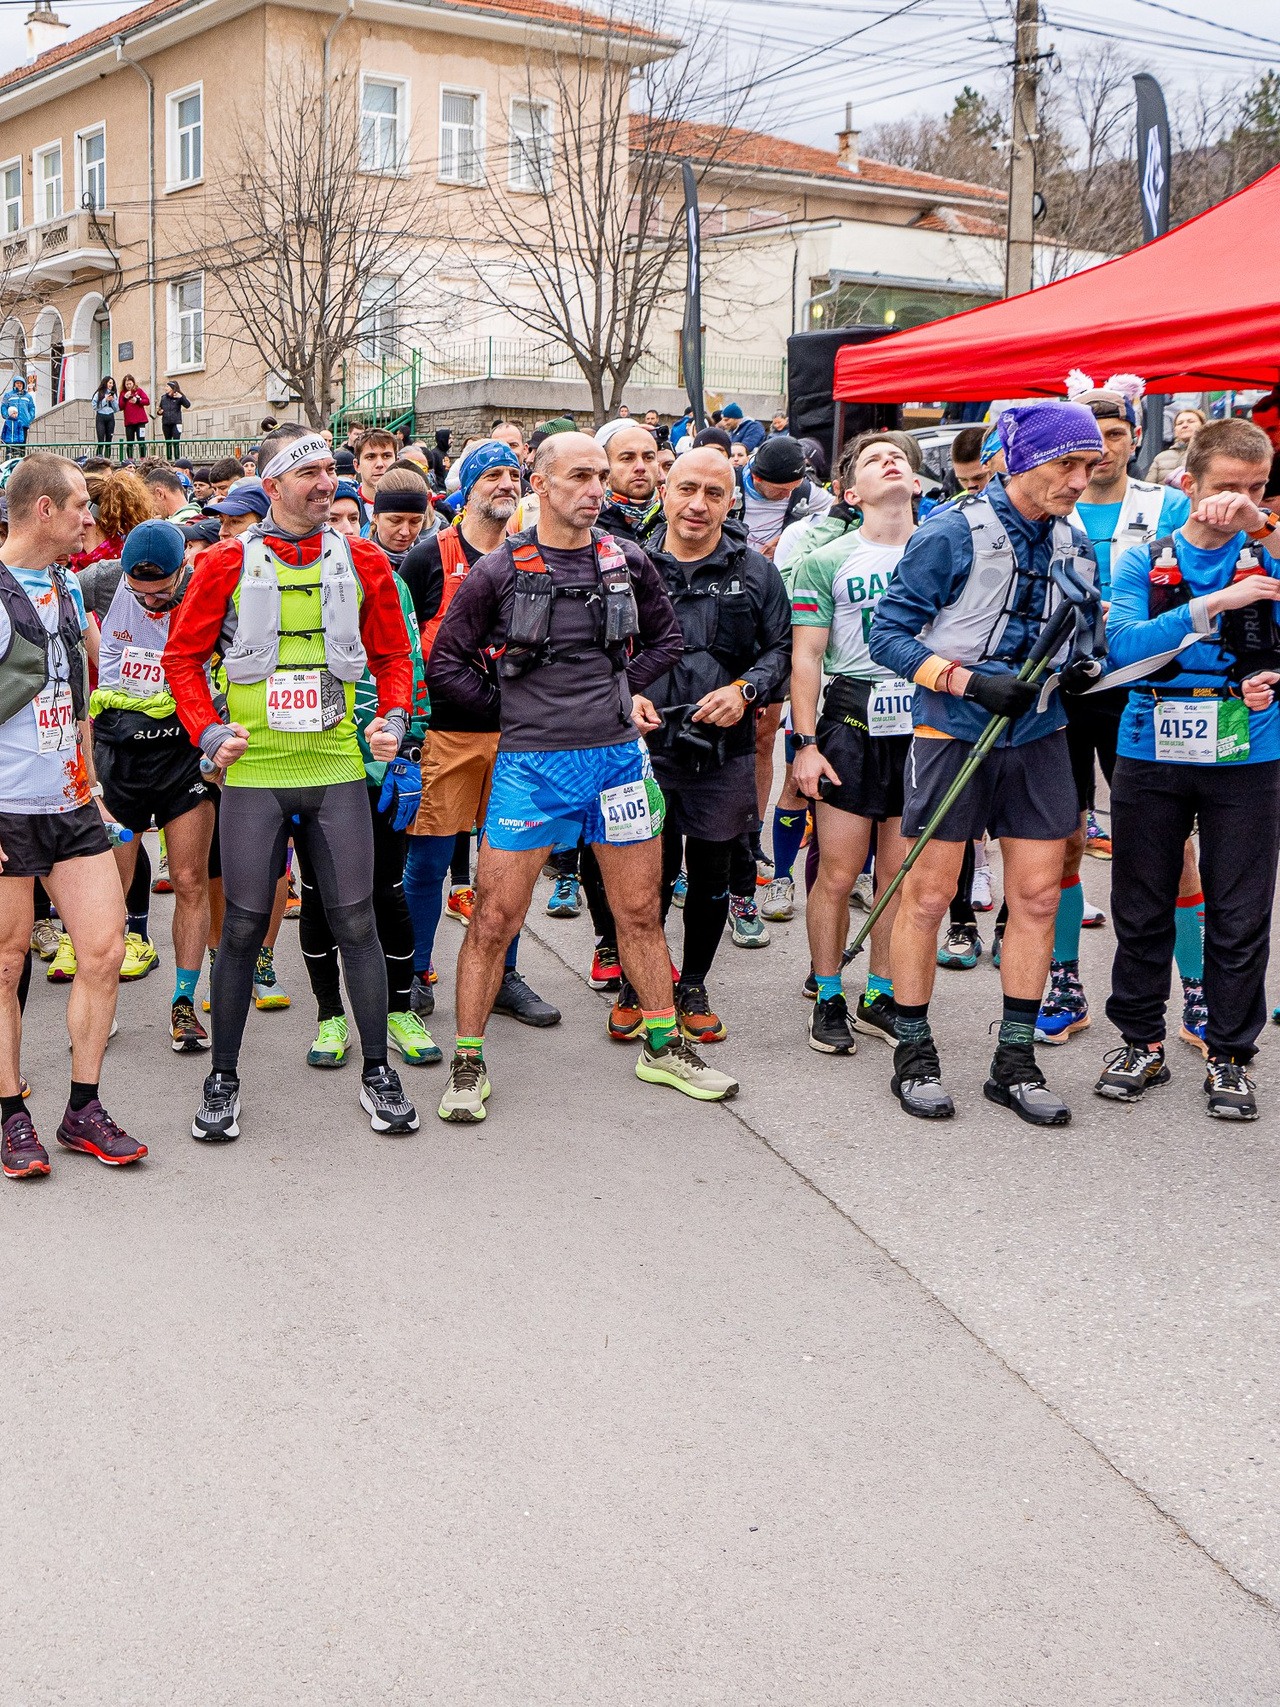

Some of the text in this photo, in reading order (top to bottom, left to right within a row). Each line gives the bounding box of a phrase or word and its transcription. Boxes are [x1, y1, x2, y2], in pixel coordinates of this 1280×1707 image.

[1242, 606, 1261, 650] IPRU
[122, 662, 161, 682] 4273
[268, 689, 318, 710] 4280
[874, 694, 914, 714] 4110
[1160, 719, 1207, 738] 4152
[608, 799, 646, 823] 4105
[498, 818, 525, 827] PLOVDIV
